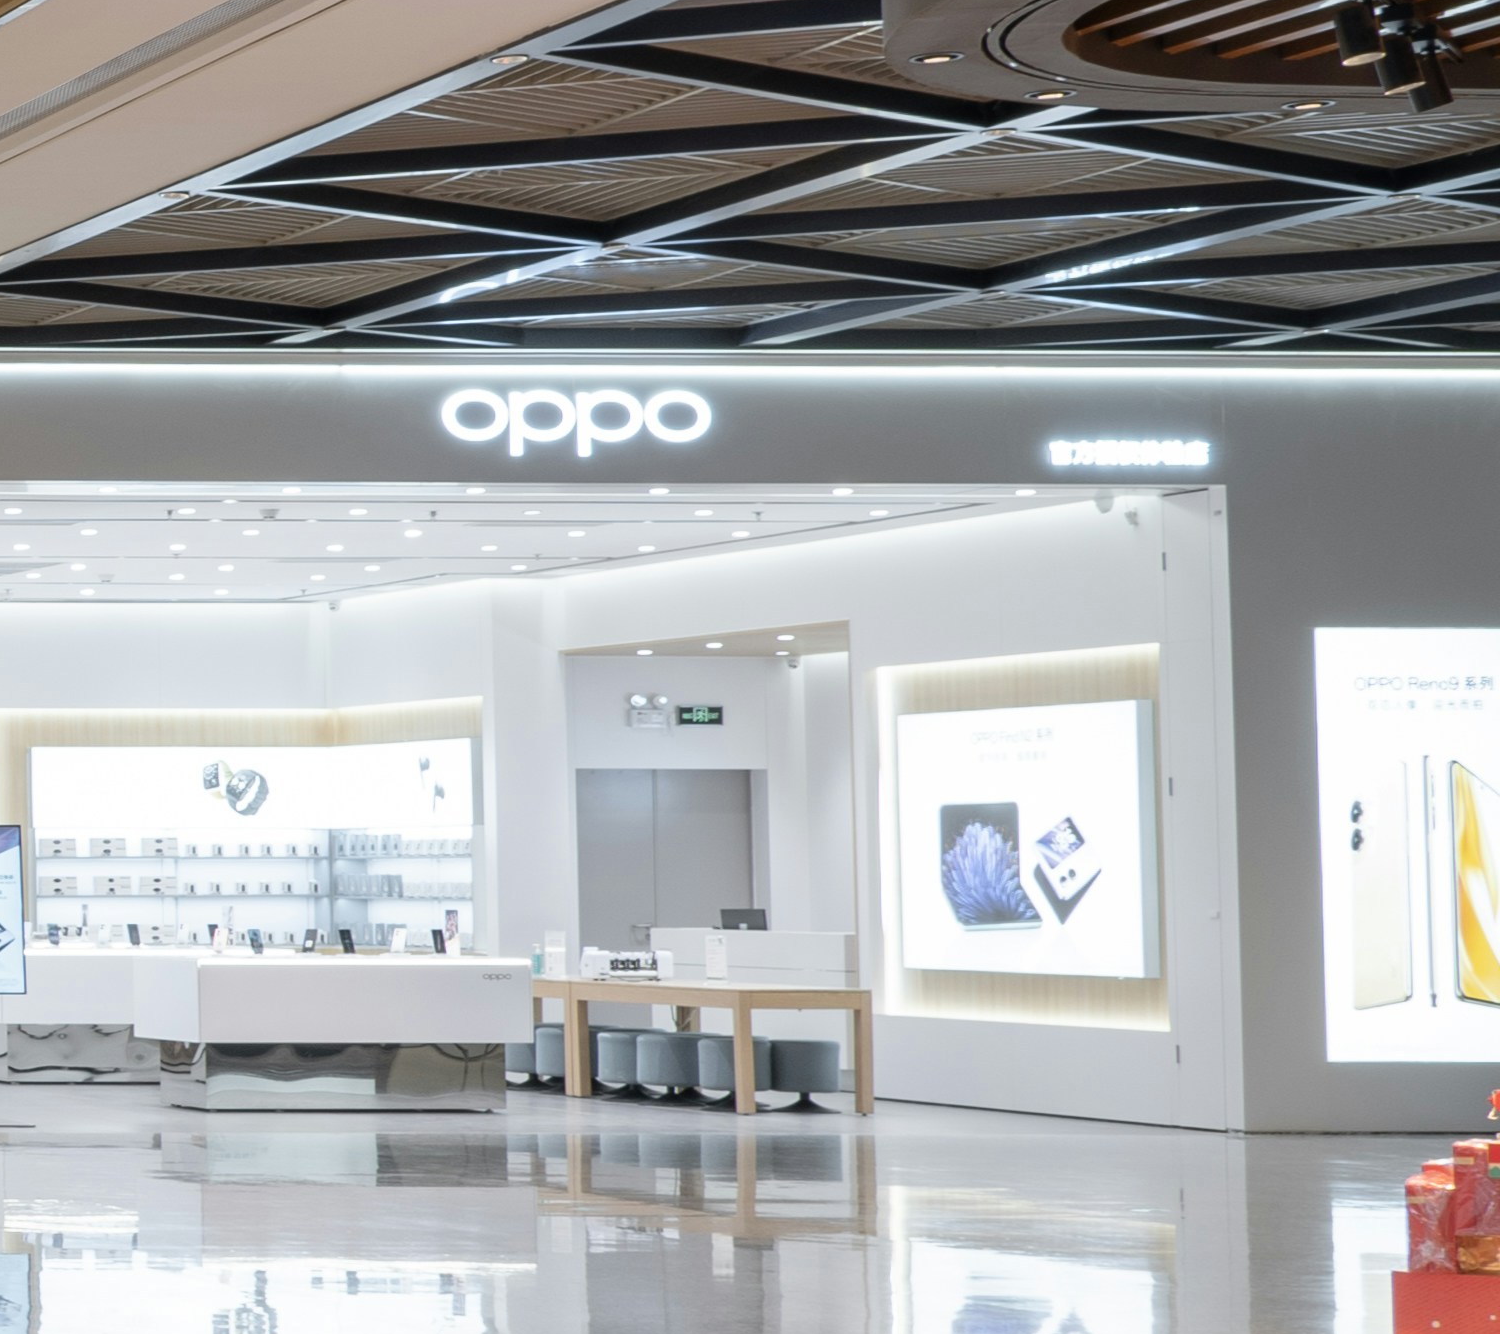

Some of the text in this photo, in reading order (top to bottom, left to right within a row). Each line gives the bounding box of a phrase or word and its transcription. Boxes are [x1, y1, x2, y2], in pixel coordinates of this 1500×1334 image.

[441, 389, 713, 457] oppo
[1354, 675, 1404, 691] OPPO
[1465, 675, 1494, 691] 系列
[482, 973, 512, 982] oppo
